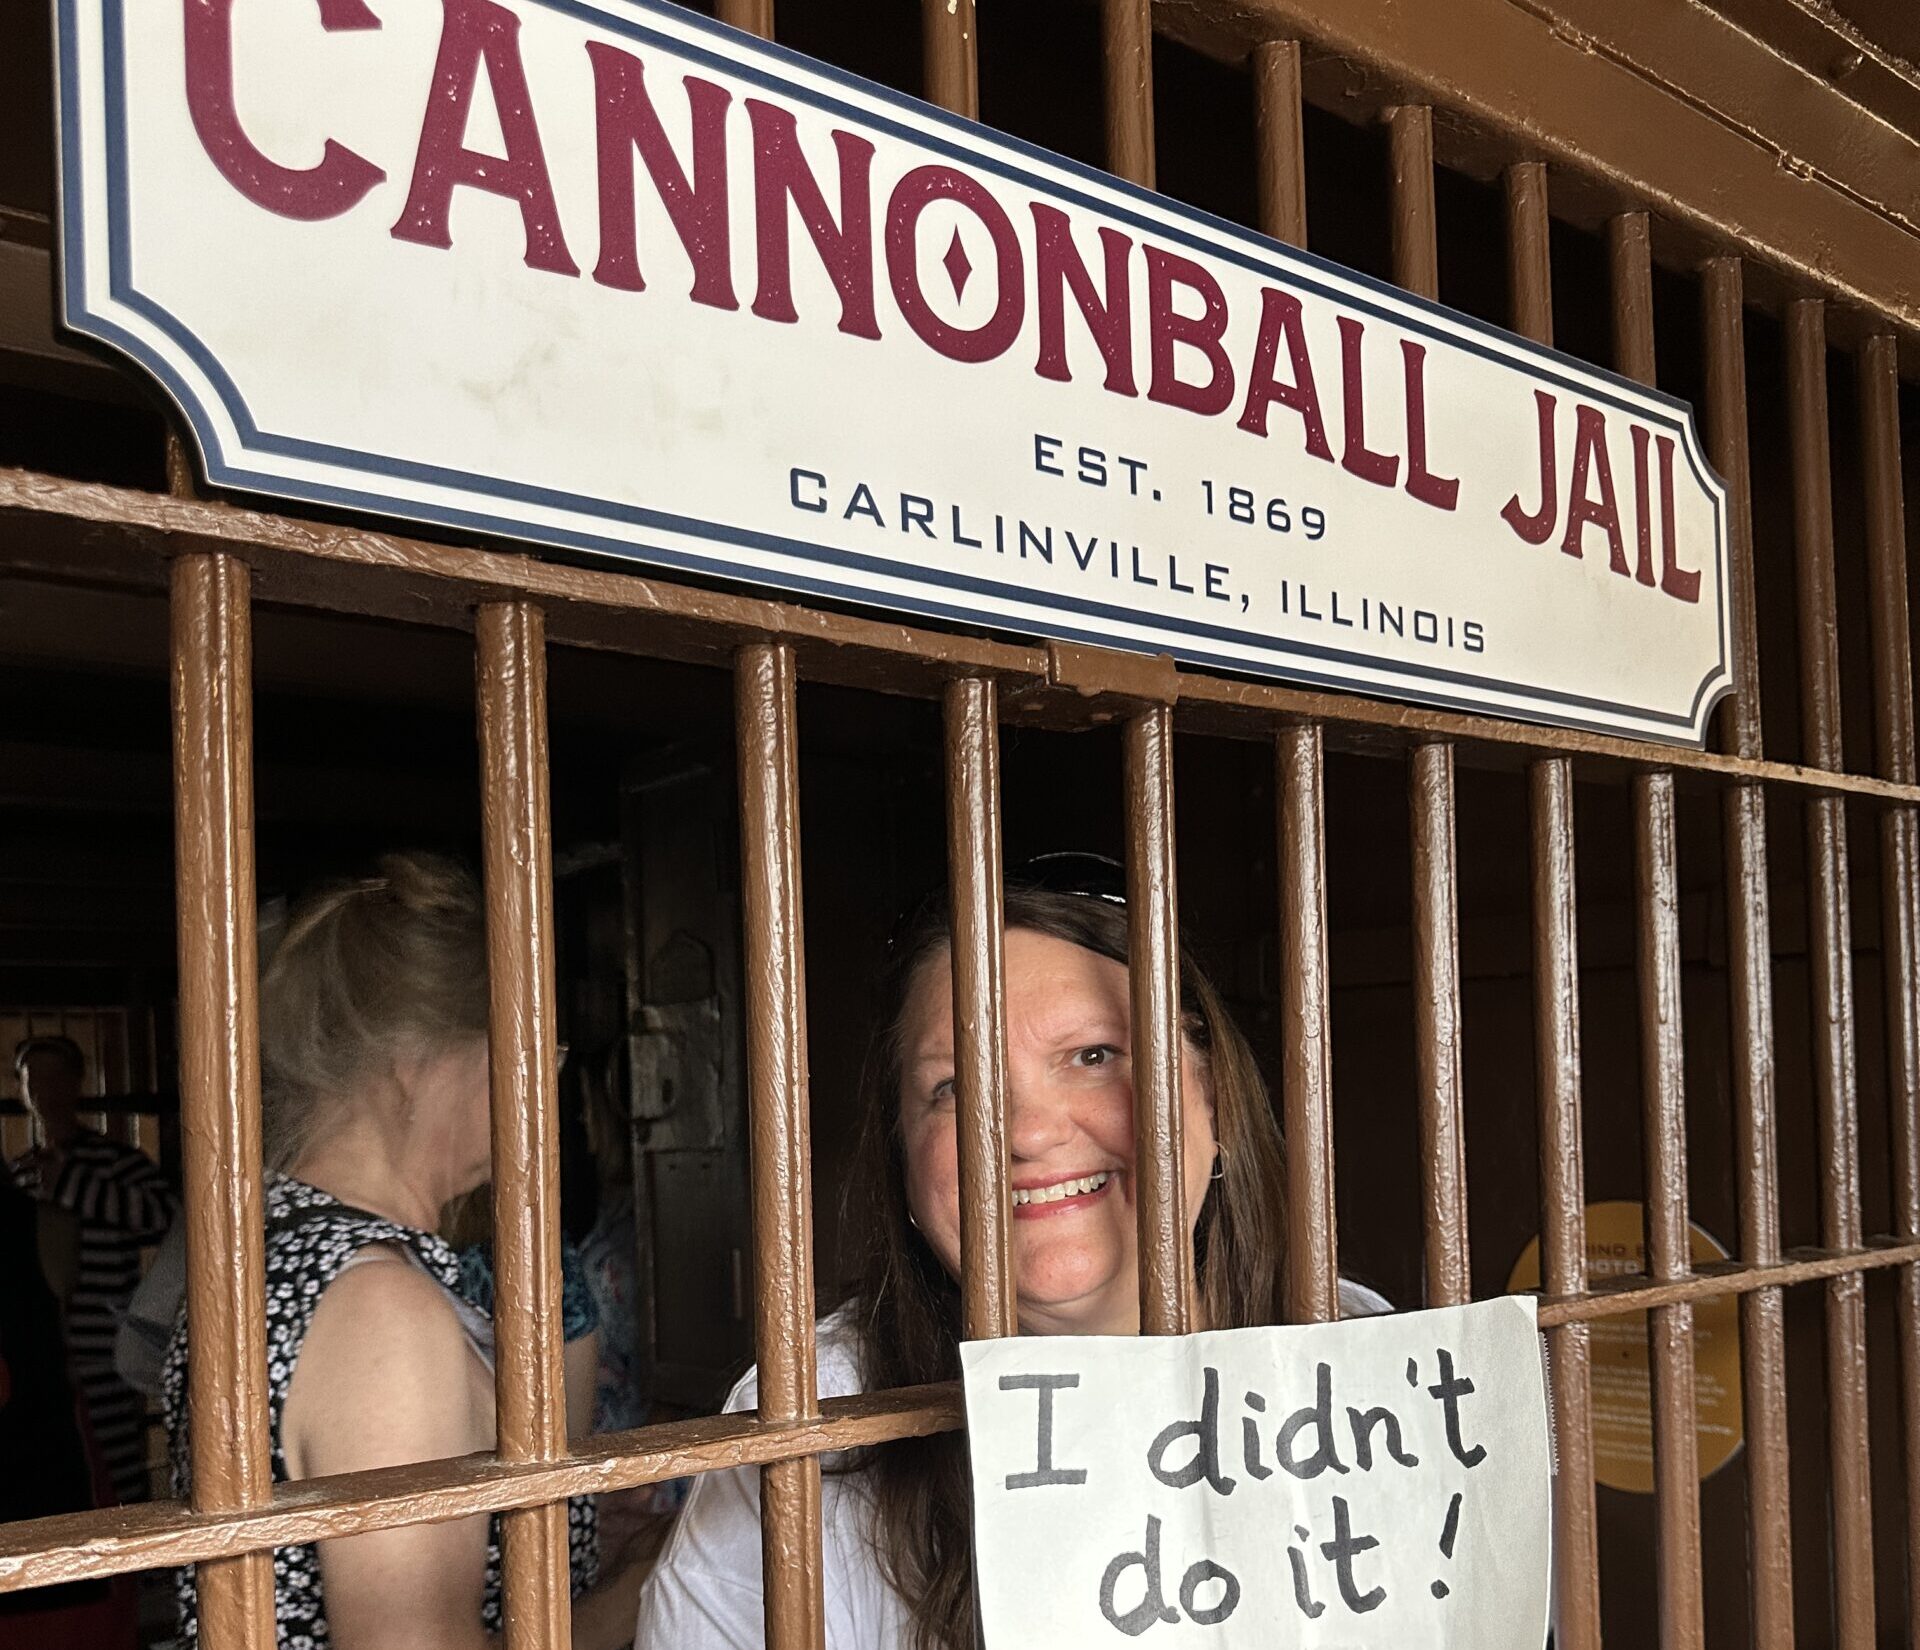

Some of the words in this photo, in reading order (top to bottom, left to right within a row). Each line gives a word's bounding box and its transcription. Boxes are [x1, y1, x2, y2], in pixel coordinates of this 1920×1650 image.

[182, 0, 1459, 511] CANNONBALL
[1502, 390, 1702, 604] JAIL
[790, 467, 1250, 613] CARLINVILLE,
[1281, 580, 1485, 653] ILLINOIS
[1034, 433, 1163, 502] EST.
[1201, 480, 1327, 541] 1869
[998, 1373, 1088, 1491] I
[1146, 1347, 1488, 1497] didn't
[1098, 1513, 1241, 1637] do
